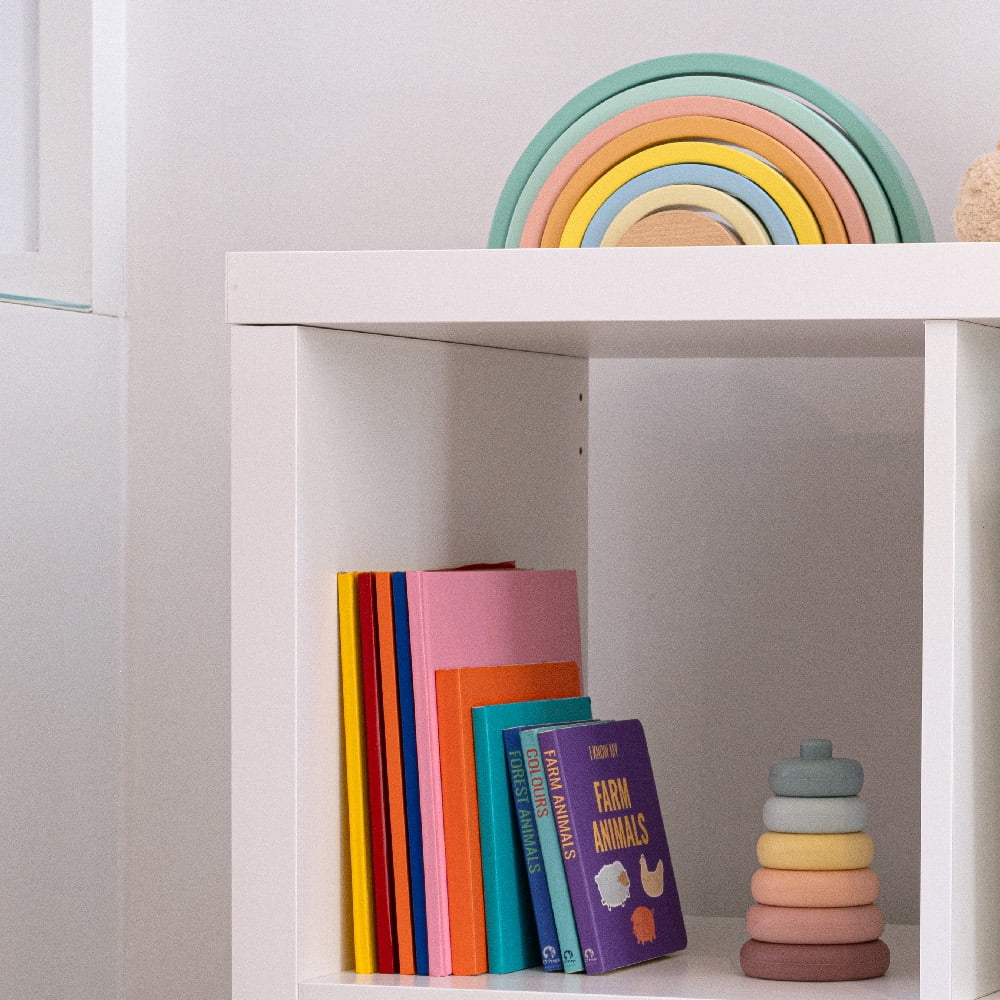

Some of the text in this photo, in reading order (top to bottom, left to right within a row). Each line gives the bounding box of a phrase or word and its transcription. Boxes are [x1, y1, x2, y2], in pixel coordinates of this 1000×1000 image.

[509, 749, 541, 874] FOREST ANIMALS
[526, 748, 549, 819] COLOURS
[543, 749, 576, 860] FARM ANIMALS
[593, 777, 632, 813] FARM
[592, 812, 649, 853] ANIMALS
